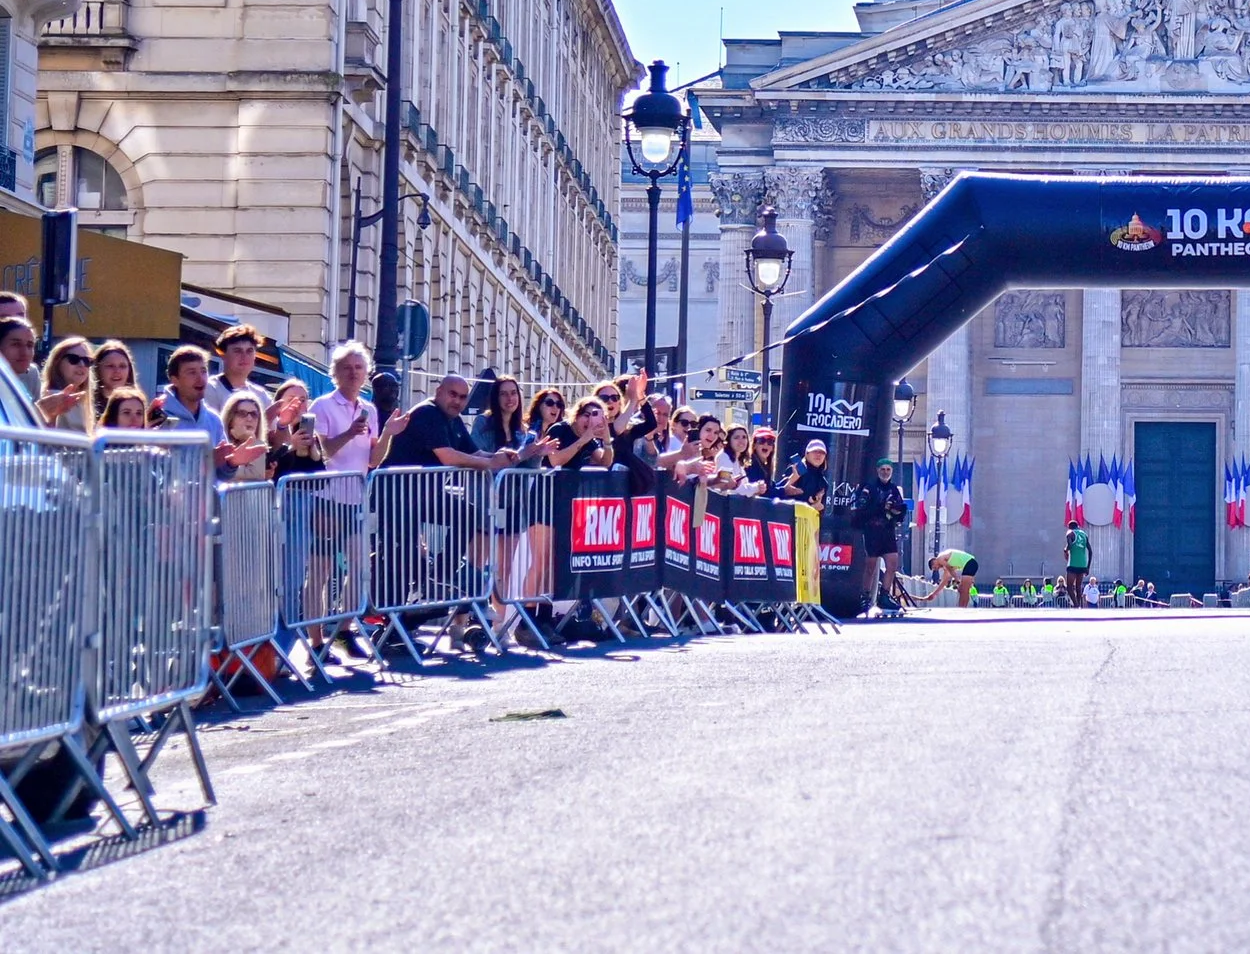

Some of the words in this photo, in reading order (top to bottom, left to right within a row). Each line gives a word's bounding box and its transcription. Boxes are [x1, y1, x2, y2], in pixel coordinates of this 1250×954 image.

[873, 123, 926, 140] AUX
[931, 123, 1027, 140] GRANDS
[1032, 123, 1133, 142] HOMMES
[1147, 124, 1177, 141] LA
[1166, 208, 1208, 240] 10
[806, 412, 862, 430] TROCADERO
[584, 504, 622, 546] RMC
[635, 503, 653, 543] RMC
[669, 505, 686, 546] RMC
[700, 519, 716, 557] RMC
[739, 524, 760, 559] RMC
[818, 546, 842, 562] MC
[572, 556, 592, 567] INFO
[592, 555, 611, 566] TALK
[828, 565, 850, 575] SPORT
